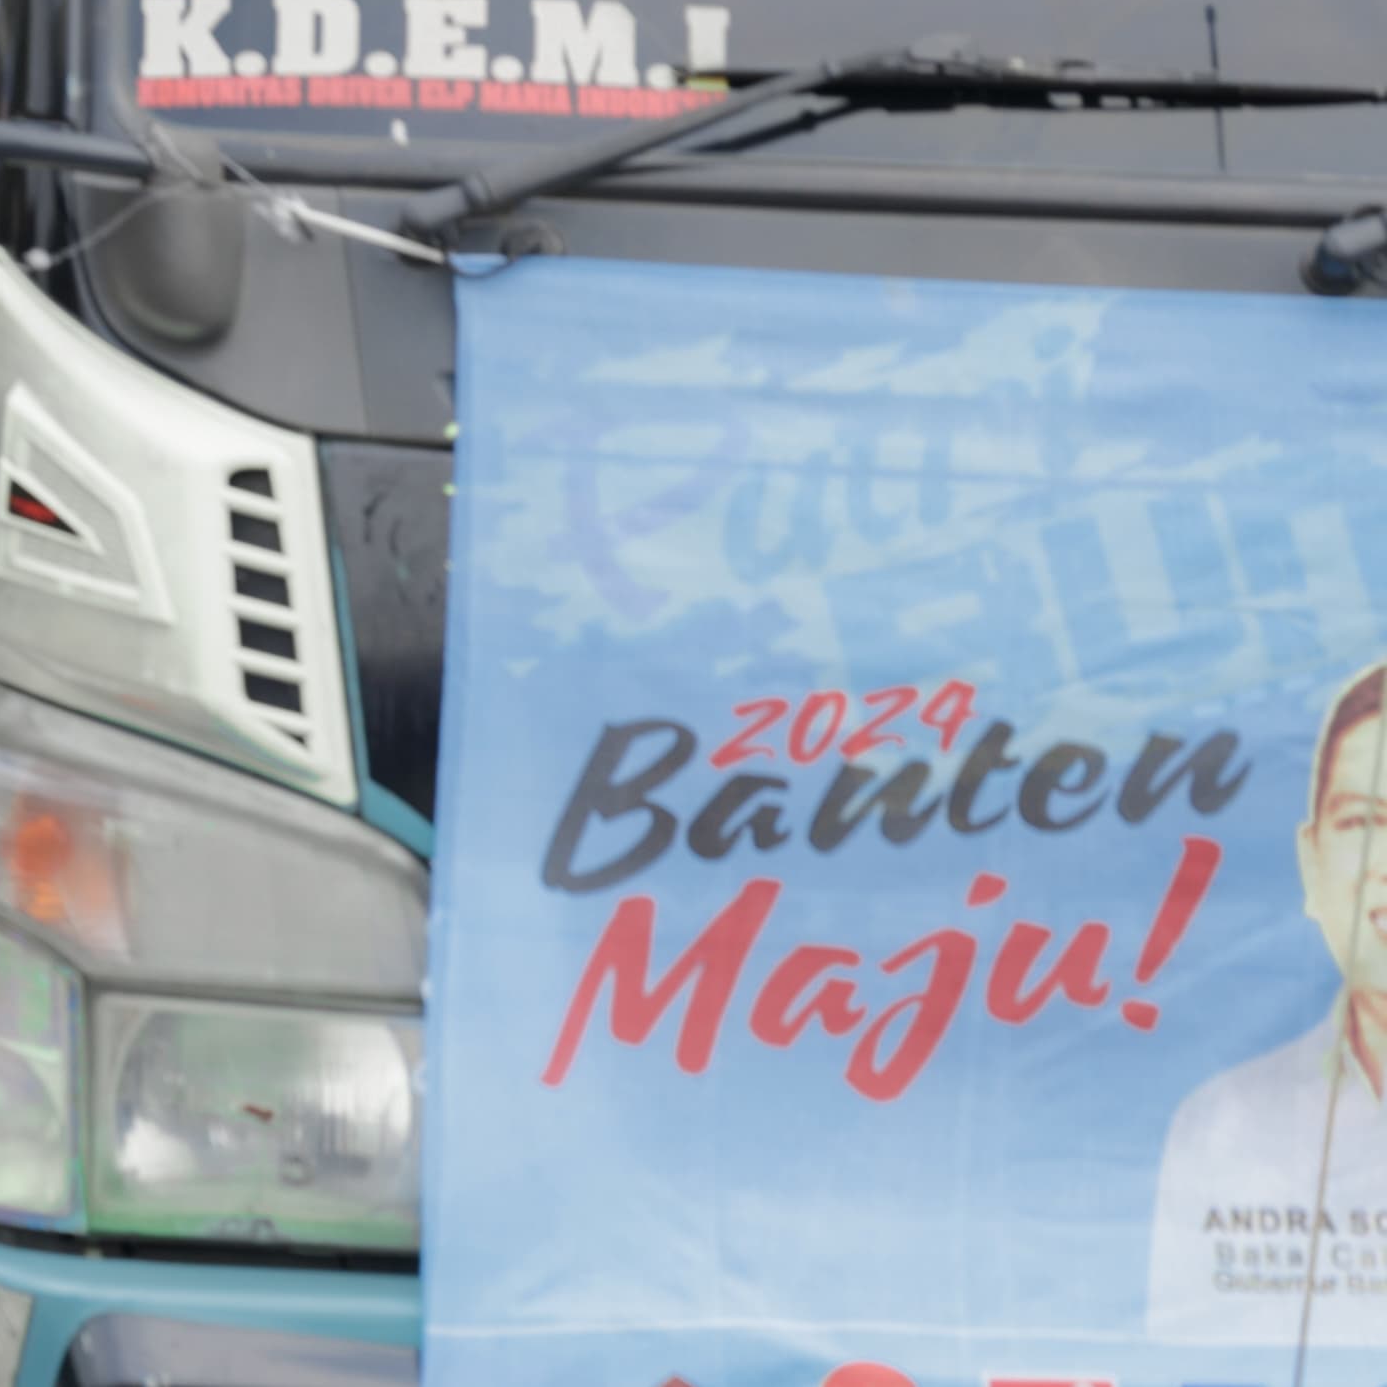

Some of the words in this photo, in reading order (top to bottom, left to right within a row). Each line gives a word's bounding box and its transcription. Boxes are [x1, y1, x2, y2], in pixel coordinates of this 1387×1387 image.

[708, 679, 977, 771] 2024
[540, 717, 1253, 896] Banten
[540, 835, 1222, 1103] Maju!
[1203, 1205, 1337, 1235] ANDRA
